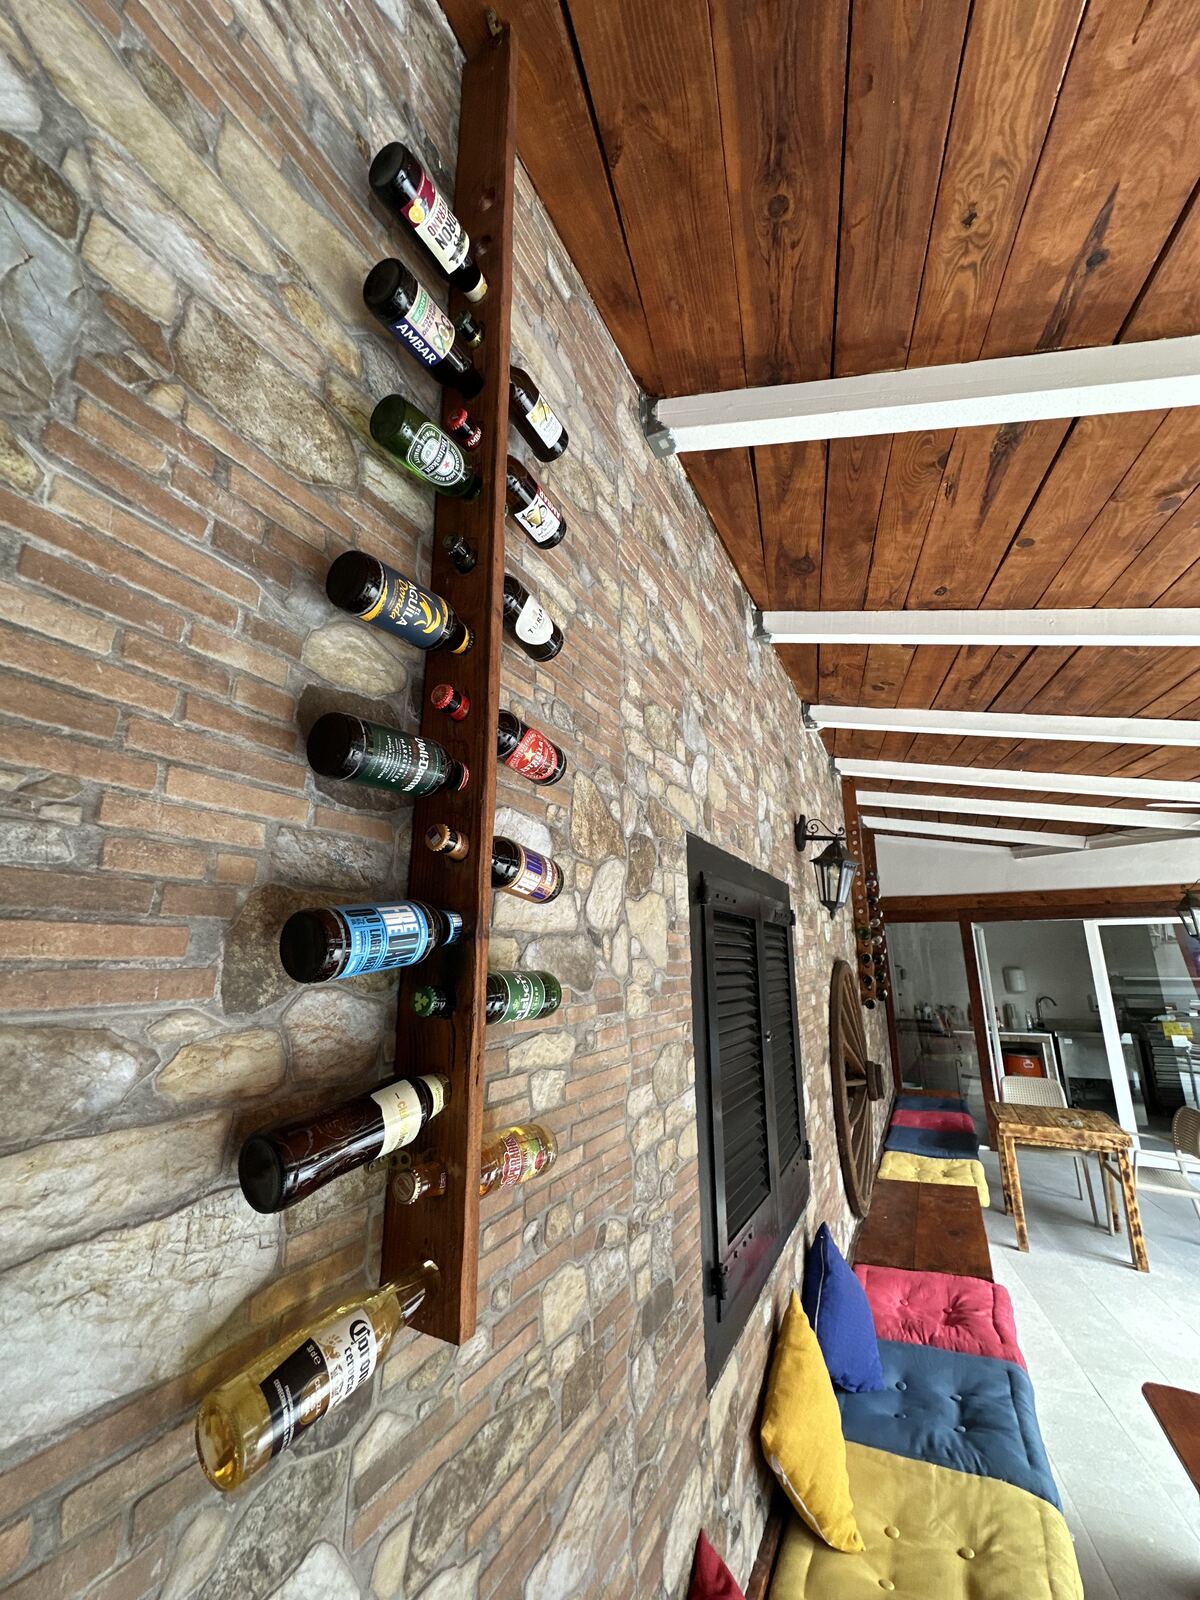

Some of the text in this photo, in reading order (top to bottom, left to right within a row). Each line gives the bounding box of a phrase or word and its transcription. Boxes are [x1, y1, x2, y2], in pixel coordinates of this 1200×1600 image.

[396, 325, 437, 364] AMBAR
[424, 438, 447, 473] Heineken
[389, 578, 408, 619] Dorada
[528, 608, 543, 634] TURIA
[401, 737, 428, 791] Voll-Damm
[369, 929, 382, 954] LAGER
[349, 1319, 372, 1384] Coron
